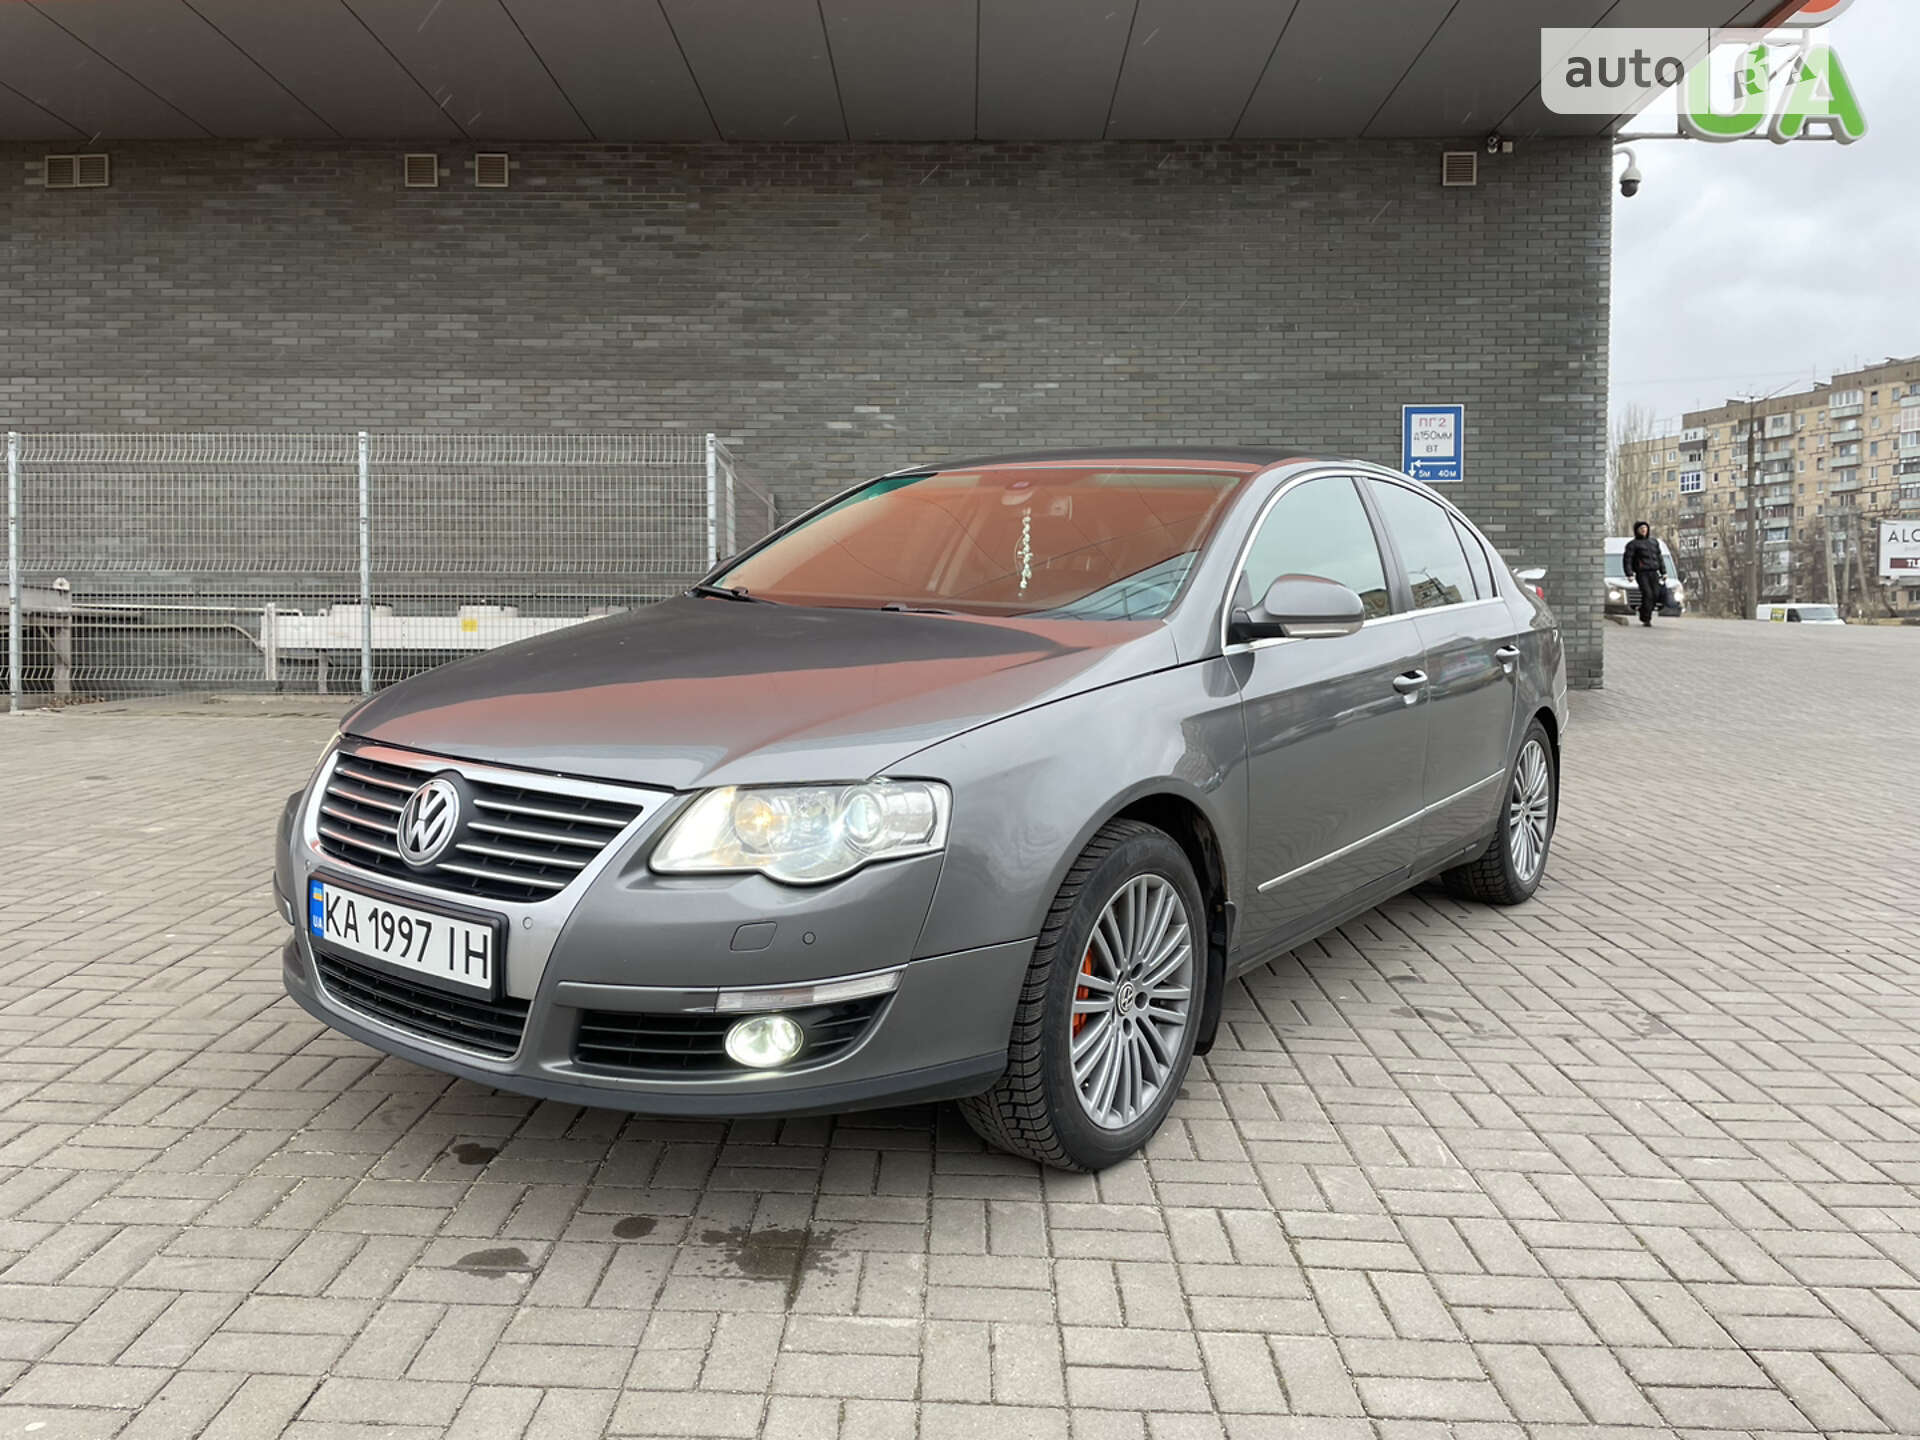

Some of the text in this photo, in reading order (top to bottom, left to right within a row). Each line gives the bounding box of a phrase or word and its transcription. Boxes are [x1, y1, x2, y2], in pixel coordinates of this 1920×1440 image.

[325, 891, 489, 979] KA 1997 IH
